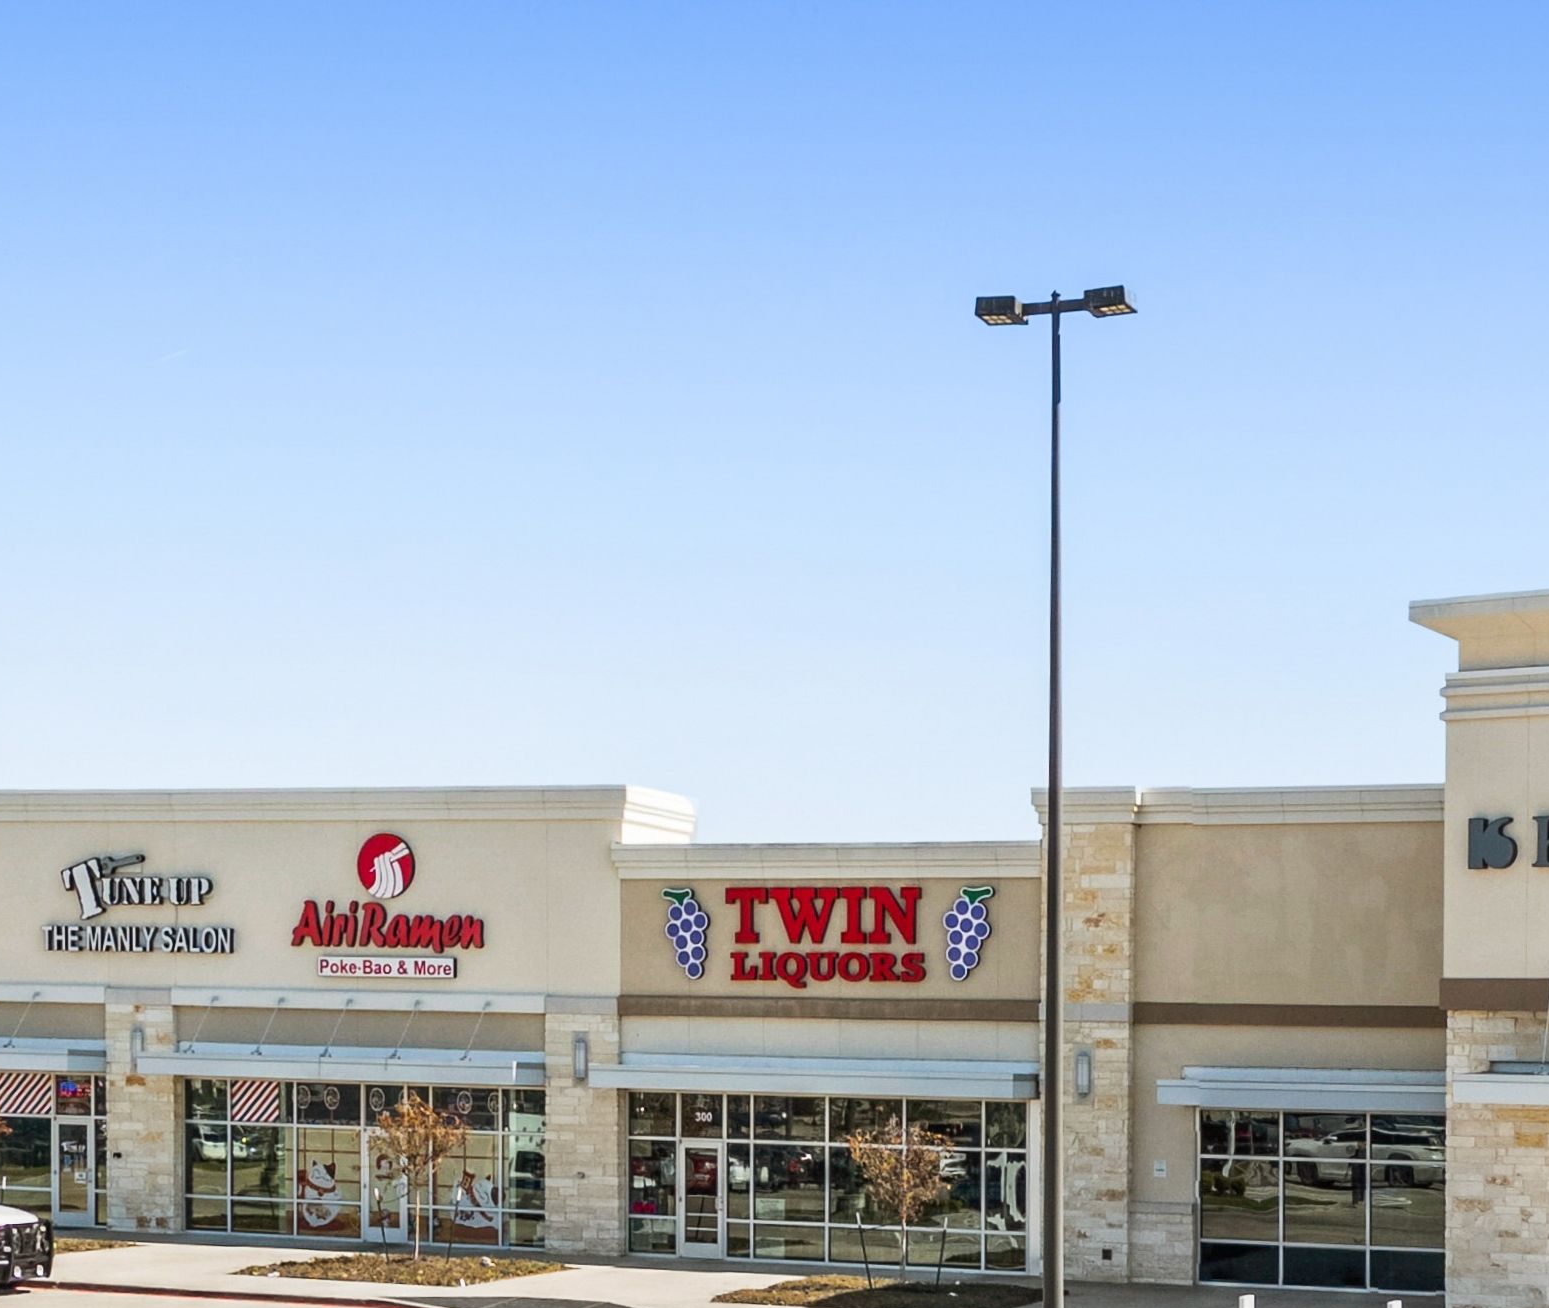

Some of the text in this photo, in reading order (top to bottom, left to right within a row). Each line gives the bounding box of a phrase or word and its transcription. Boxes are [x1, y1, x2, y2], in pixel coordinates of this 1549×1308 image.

[168, 876, 214, 906] UP
[724, 886, 922, 945] TWIN
[42, 925, 235, 954] THE MANLY SALON
[397, 961, 408, 975] &
[414, 960, 452, 976] More
[729, 951, 926, 989] LIQUORS
[694, 1111, 713, 1123] 300
